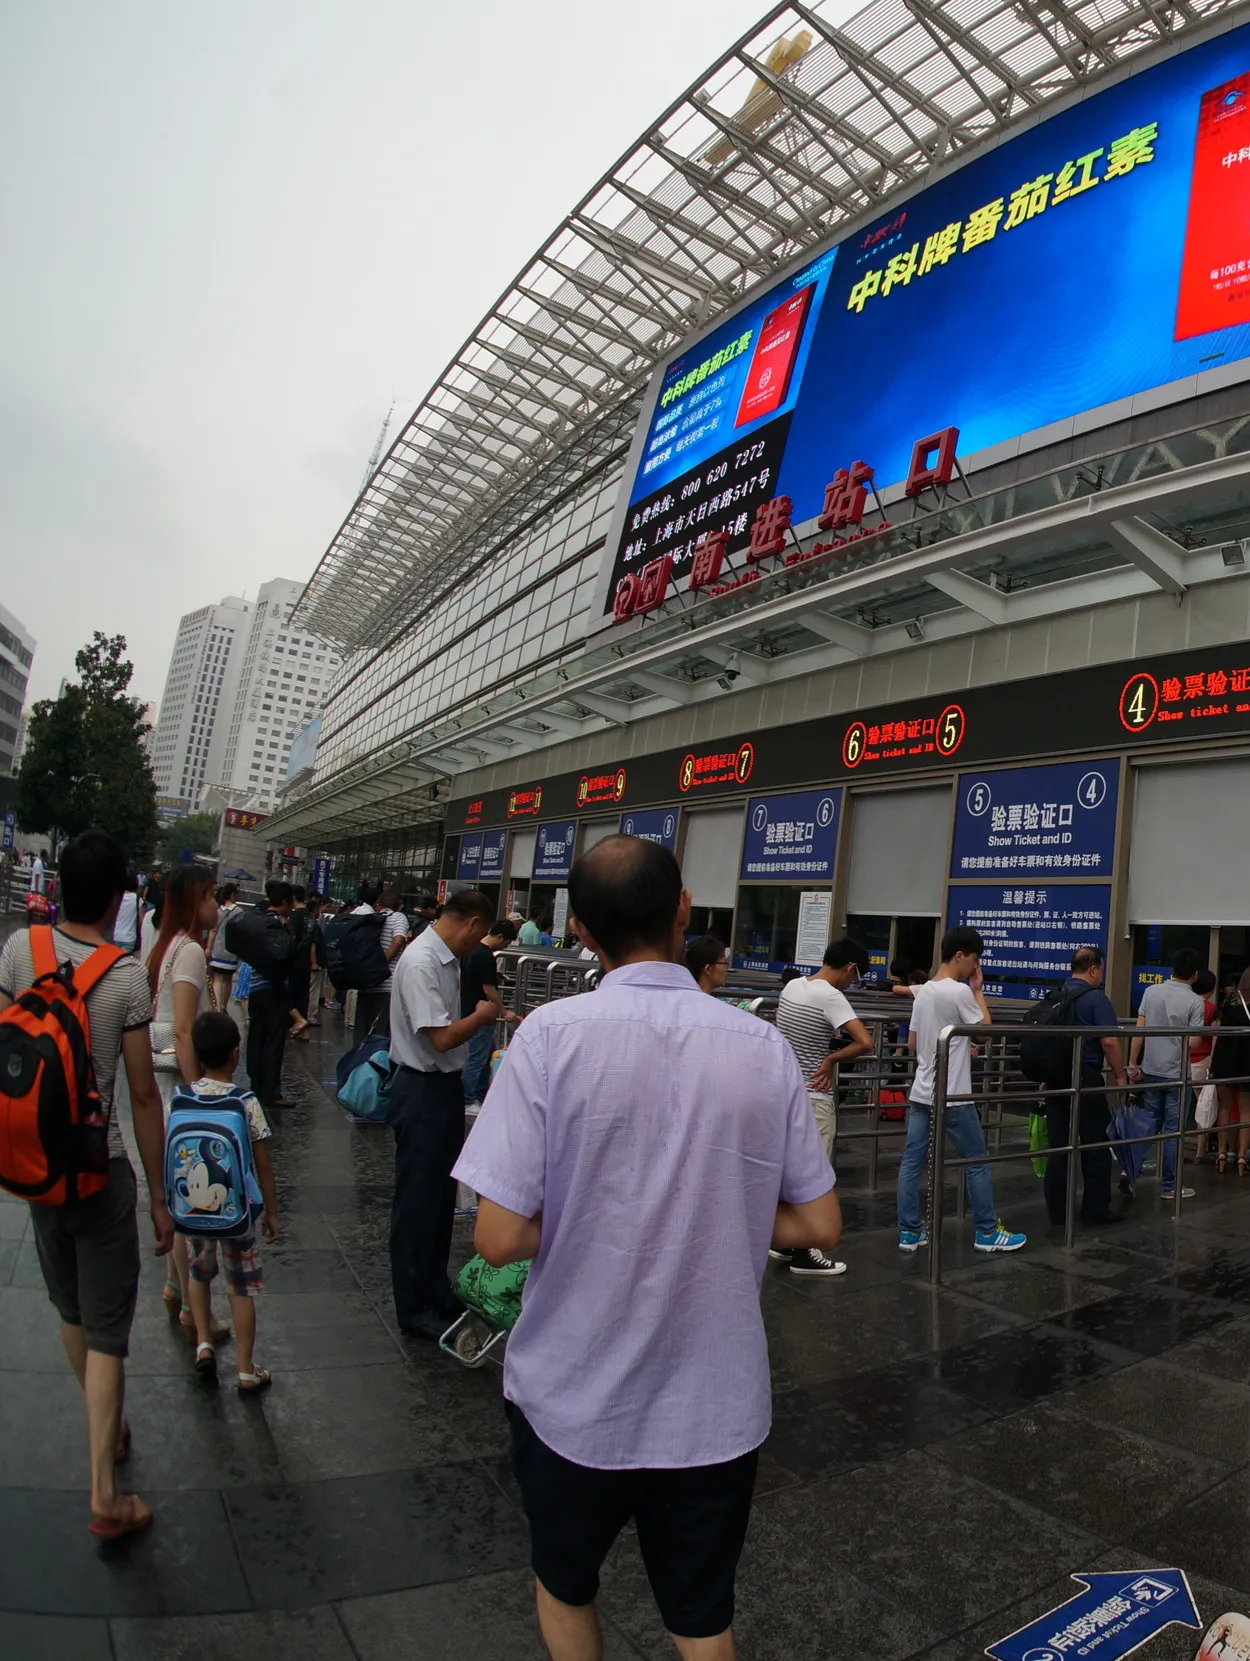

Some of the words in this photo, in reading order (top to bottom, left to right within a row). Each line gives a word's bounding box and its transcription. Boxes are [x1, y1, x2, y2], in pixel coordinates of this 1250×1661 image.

[847, 121, 1158, 313] 中科牌番茄红素
[661, 329, 753, 408] 中科牌番茄红素
[681, 477, 701, 501] 800
[706, 462, 727, 485] 620
[735, 440, 765, 469] 7272
[1128, 683, 1146, 723] 4
[1158, 710, 1183, 722] Show
[1190, 705, 1229, 717] ticket
[848, 730, 860, 761] 6
[867, 718, 935, 745] 验票验证口
[943, 713, 958, 748] 5
[683, 761, 693, 786] 8
[741, 751, 749, 777] 7
[579, 782, 588, 800] 10
[617, 774, 624, 797] 9
[975, 789, 984, 812] 5
[1086, 778, 1097, 803] 4
[991, 802, 1073, 832] 验票验证口
[766, 822, 814, 844] 验票验证口
[988, 836, 1012, 847] Show
[1014, 834, 1041, 845] Ticket
[1042, 833, 1060, 844] and
[1061, 832, 1072, 844] ID
[763, 847, 777, 855] Show
[778, 846, 794, 854] Ticket
[794, 845, 805, 854] and
[805, 845, 812, 853] ID
[961, 853, 1101, 869] 请您提前准备好车票和有效身份证件
[1002, 890, 1048, 905] 温馨提示
[1127, 1607, 1150, 1622] Show
[1103, 1621, 1128, 1639] Ticket
[1077, 1645, 1088, 1656] ID
[1087, 1636, 1103, 1649] and
